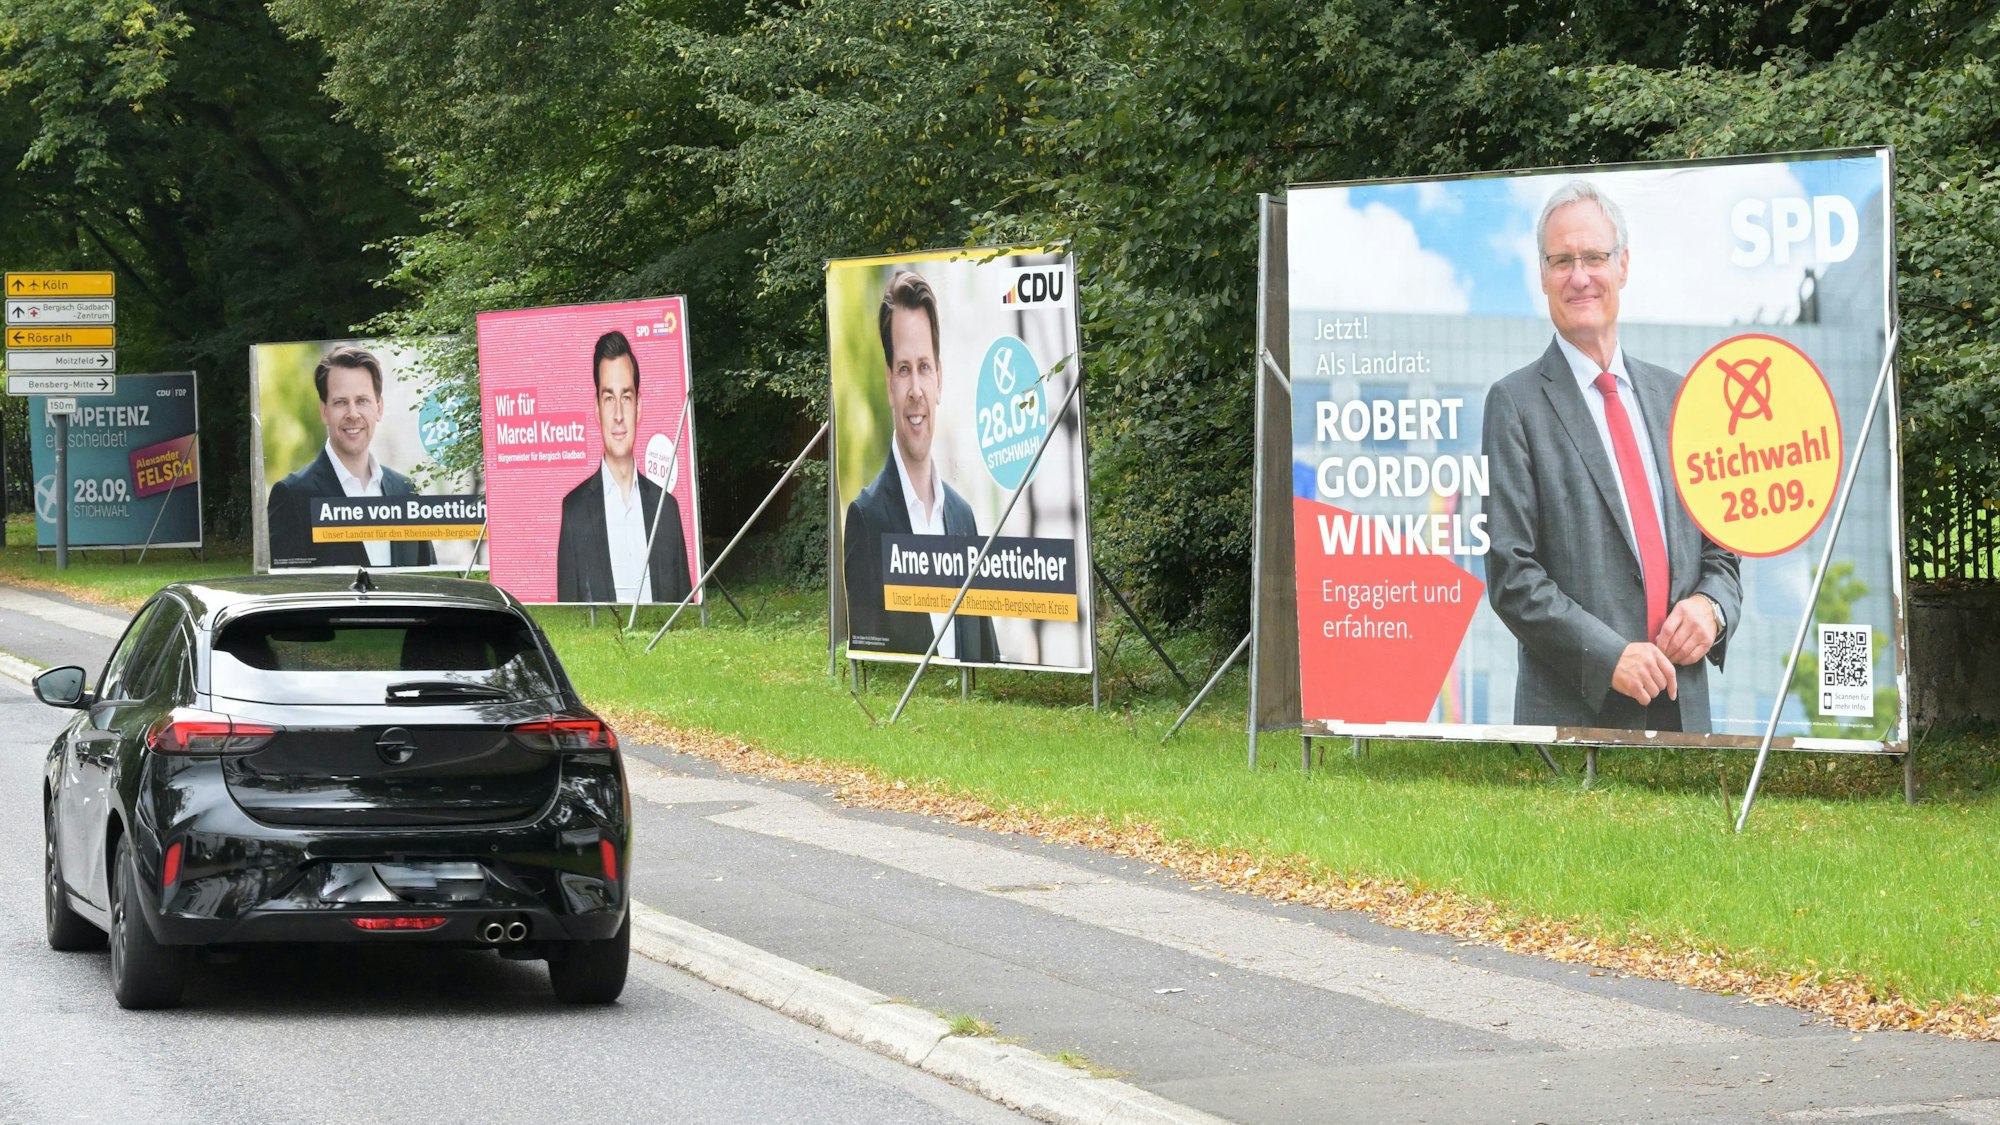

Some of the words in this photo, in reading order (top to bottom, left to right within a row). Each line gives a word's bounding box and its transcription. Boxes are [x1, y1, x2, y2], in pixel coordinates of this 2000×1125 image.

[1731, 194, 1859, 267] SPD
[42, 280, 69, 290] Köln
[1017, 271, 1064, 303] CDU
[43, 304, 75, 312] Bergisch
[76, 303, 110, 311] Gladbach
[73, 312, 110, 320] -Zentrum
[27, 332, 73, 343] Rösrath
[636, 325, 649, 337] SPD
[1315, 316, 1368, 341] Jetzt!
[55, 357, 94, 365] Moitzfeld
[1316, 352, 1346, 376] Als
[1351, 350, 1431, 375] Landrat:
[28, 380, 94, 390] Bensberg-Mitte
[155, 389, 171, 397] CDU
[174, 388, 187, 396] FDP
[495, 394, 515, 416] Wir
[517, 392, 535, 415] für
[45, 405, 150, 428] KMPETENZ
[979, 391, 1046, 449] 28.09.
[1316, 398, 1464, 442] ROBERT
[497, 421, 538, 445] Marcel
[541, 420, 585, 442] Kreutz
[136, 450, 179, 469] Alexander
[1686, 425, 1831, 485] Stichwahl
[136, 459, 193, 489] FELSCH
[1317, 455, 1490, 498] GORDON
[73, 478, 131, 502] 28.09.
[1721, 479, 1815, 523] 28.09.
[73, 504, 130, 518] STICHWAHL
[319, 503, 364, 521] Arne
[367, 504, 402, 520] von
[406, 500, 487, 519] Boettich
[322, 531, 344, 539] Unser
[345, 530, 373, 539] Landrat
[375, 529, 387, 538] für
[389, 529, 402, 538] den
[1317, 513, 1491, 556] WINKELS
[890, 544, 929, 575] Arne
[932, 552, 964, 576] von
[967, 546, 1067, 582] Boetticher
[892, 592, 912, 606] Unser
[913, 593, 939, 608] Landrat
[966, 595, 1047, 615] Rheinisch-Bergischen
[1048, 601, 1069, 615] Kreis
[1322, 579, 1418, 610] Engagiert
[1424, 579, 1461, 604] und
[1323, 614, 1413, 639] erfahren.
[1834, 692, 1860, 701] Scannen
[1861, 693, 1869, 701] für
[1834, 702, 1850, 710] mehr
[1851, 702, 1866, 711] Infos
